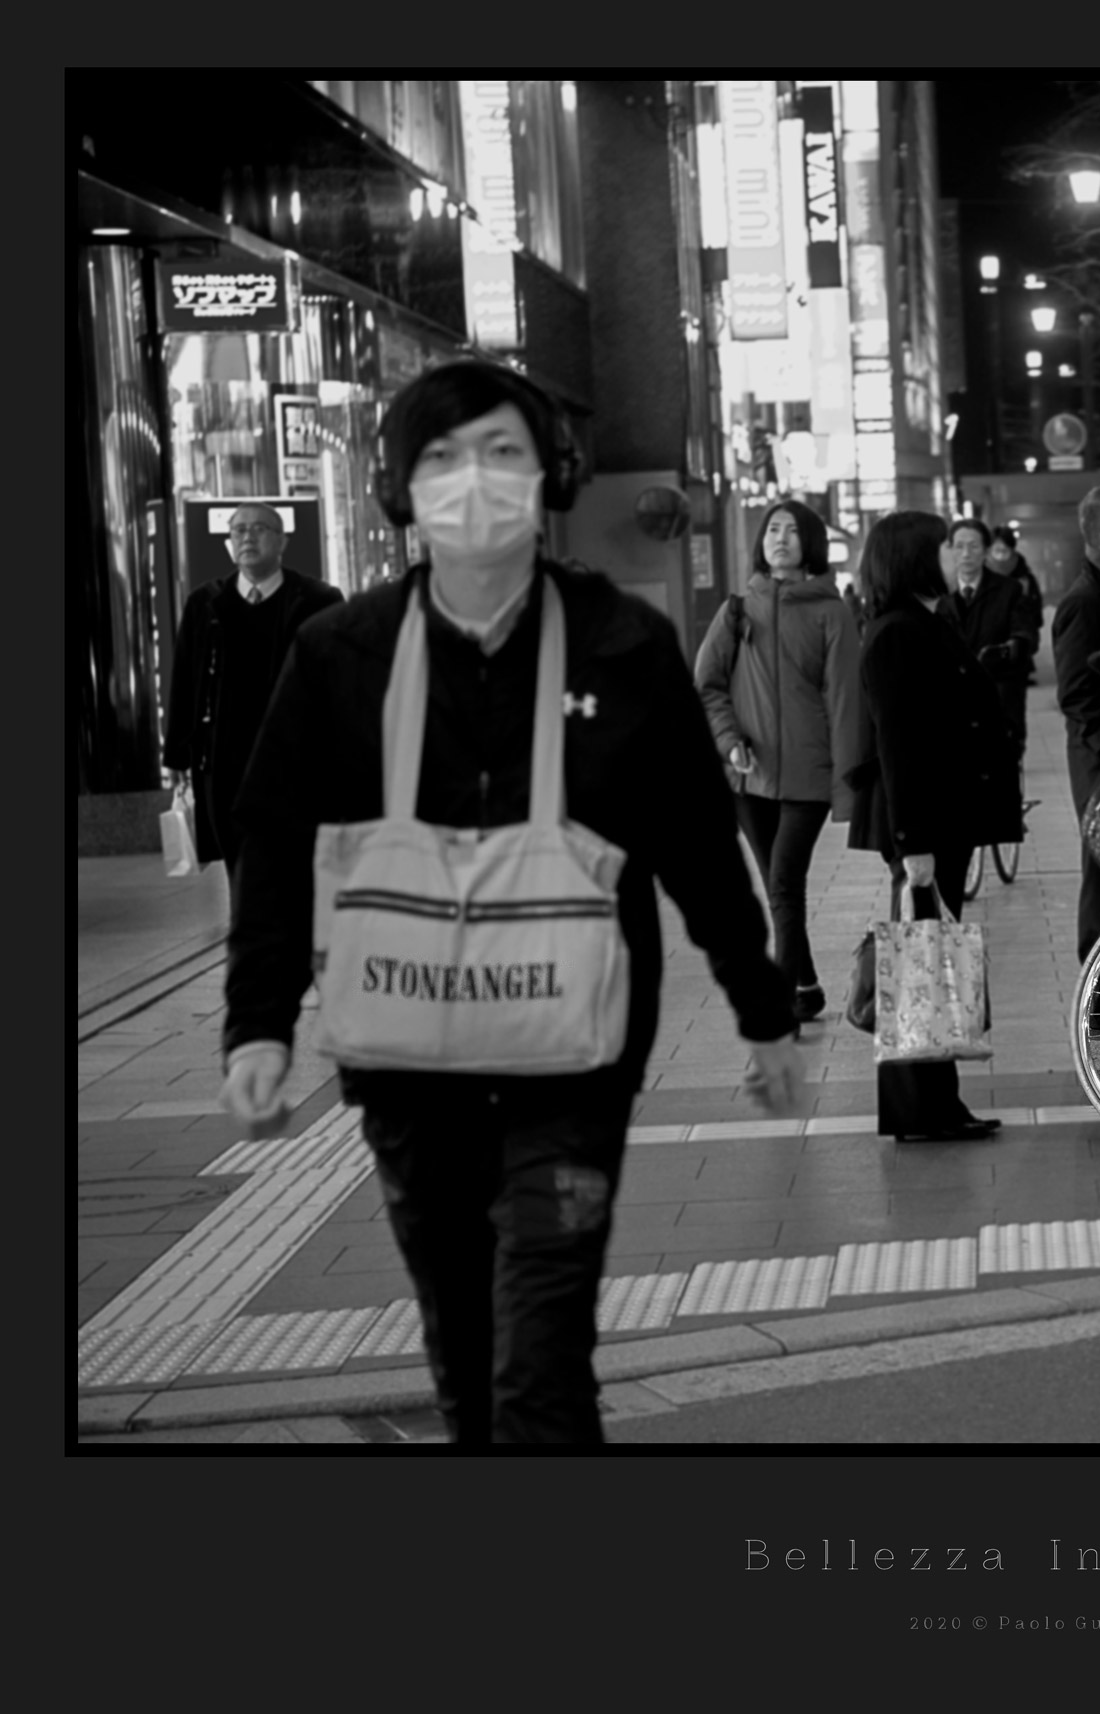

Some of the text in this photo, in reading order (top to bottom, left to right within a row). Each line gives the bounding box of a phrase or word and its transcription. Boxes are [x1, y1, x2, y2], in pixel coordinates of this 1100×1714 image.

[736, 168, 773, 240] mini
[805, 131, 838, 243] KAWAI
[362, 955, 563, 1002] STONEANGEL
